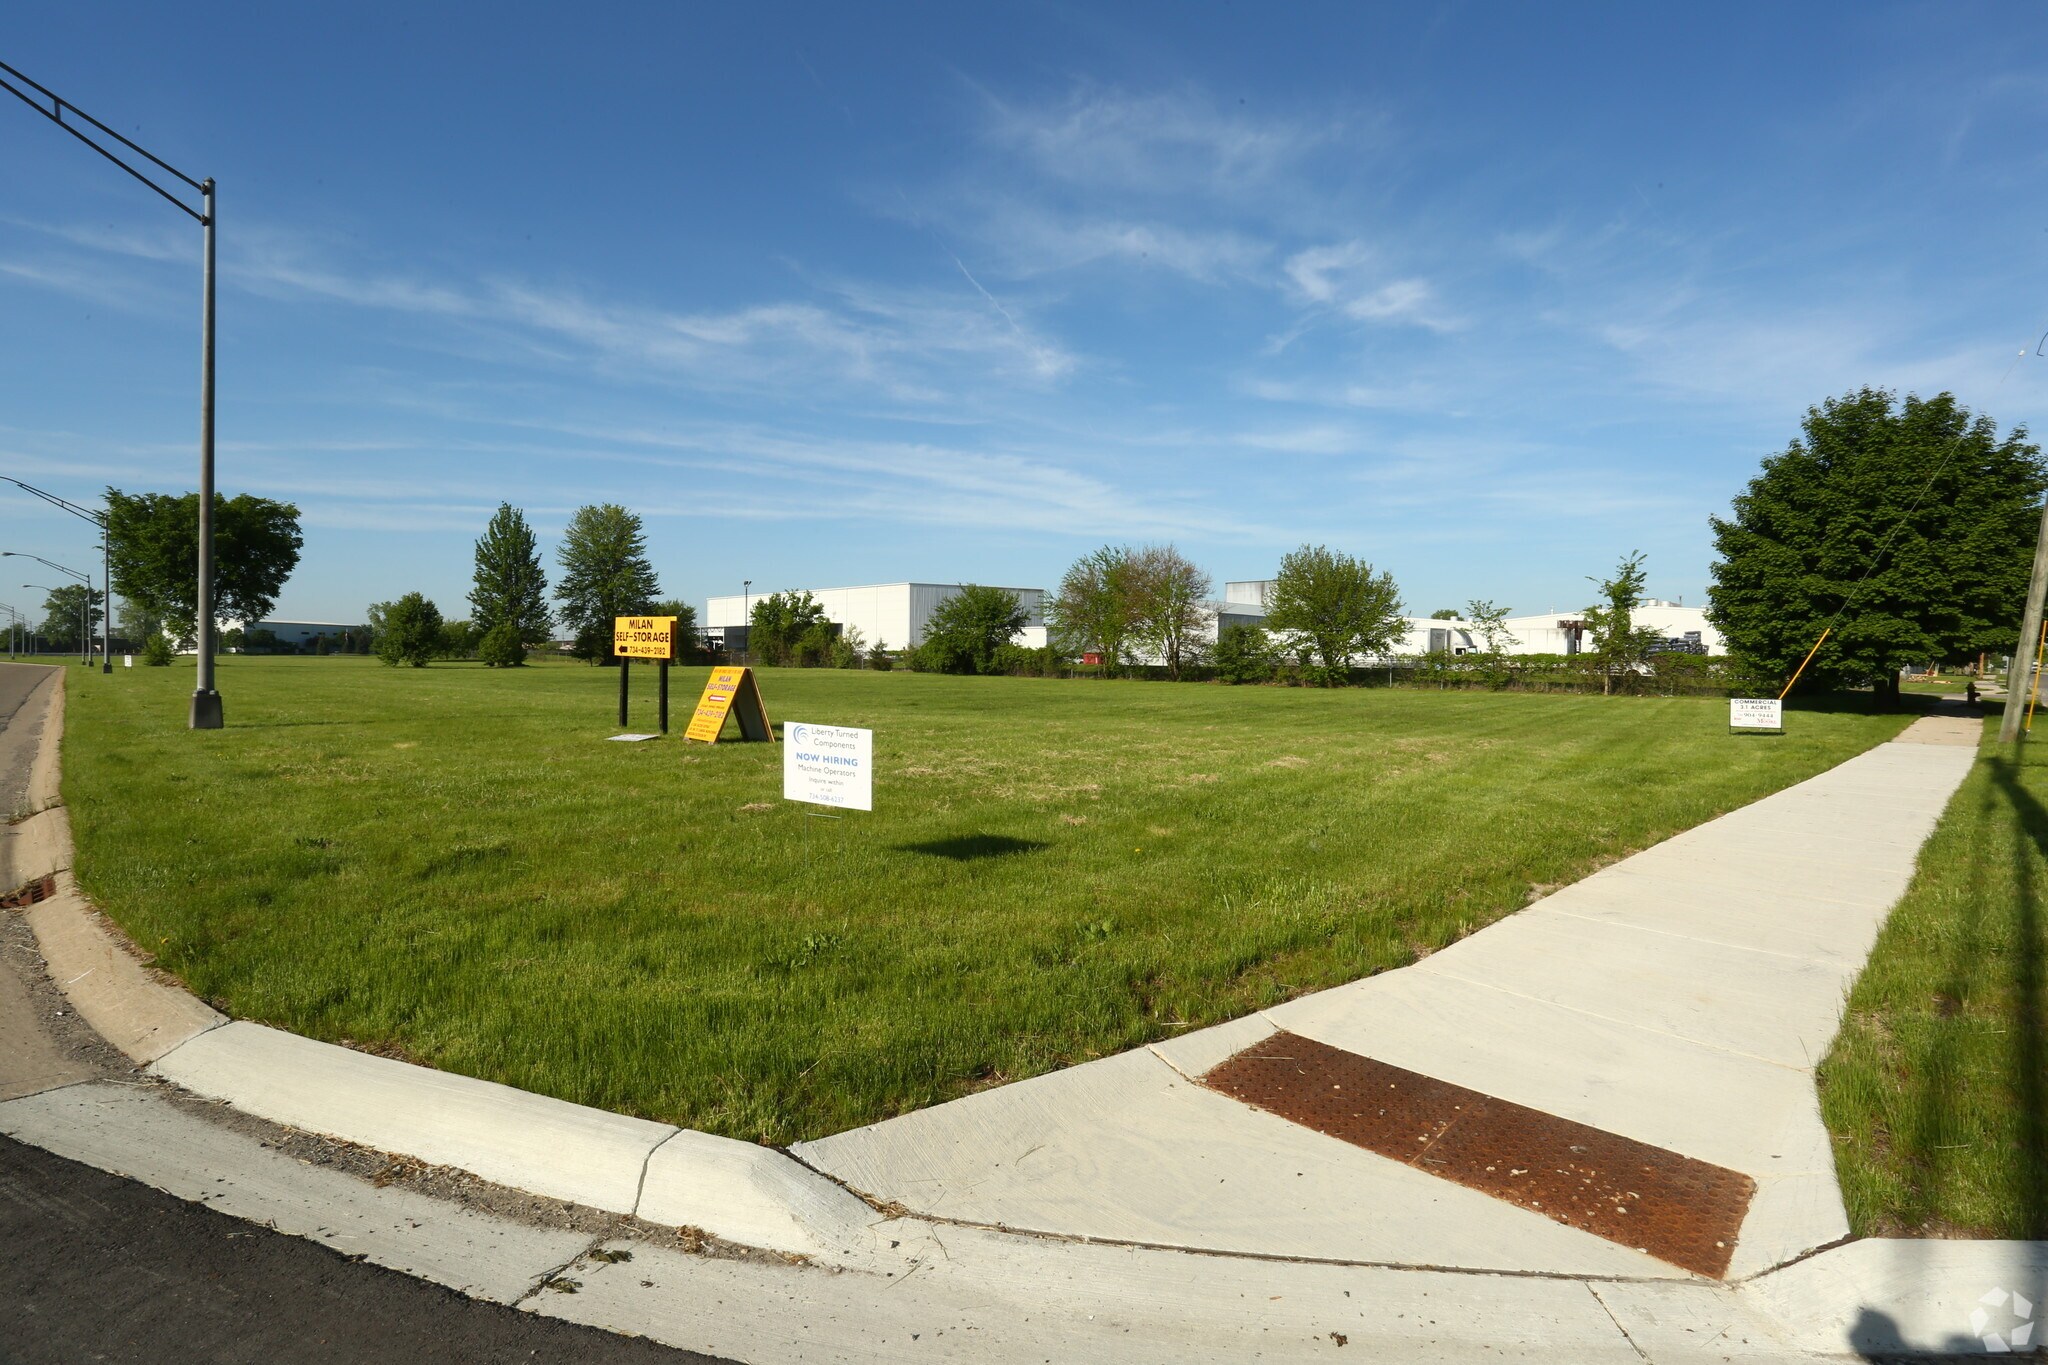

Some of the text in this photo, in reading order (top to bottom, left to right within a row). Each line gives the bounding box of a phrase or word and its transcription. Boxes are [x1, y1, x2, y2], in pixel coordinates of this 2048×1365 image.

[628, 619, 653, 629] MILAN
[616, 631, 669, 643] SELF-STORAGE
[629, 646, 666, 655] 734-439-2182
[706, 683, 737, 692] SELF-STORAGE
[811, 727, 859, 739] Liberty Turned
[813, 738, 856, 750] Components
[796, 752, 858, 767] NOW HIRING
[798, 764, 856, 777] Machine Operators
[808, 776, 827, 785] Inquire
